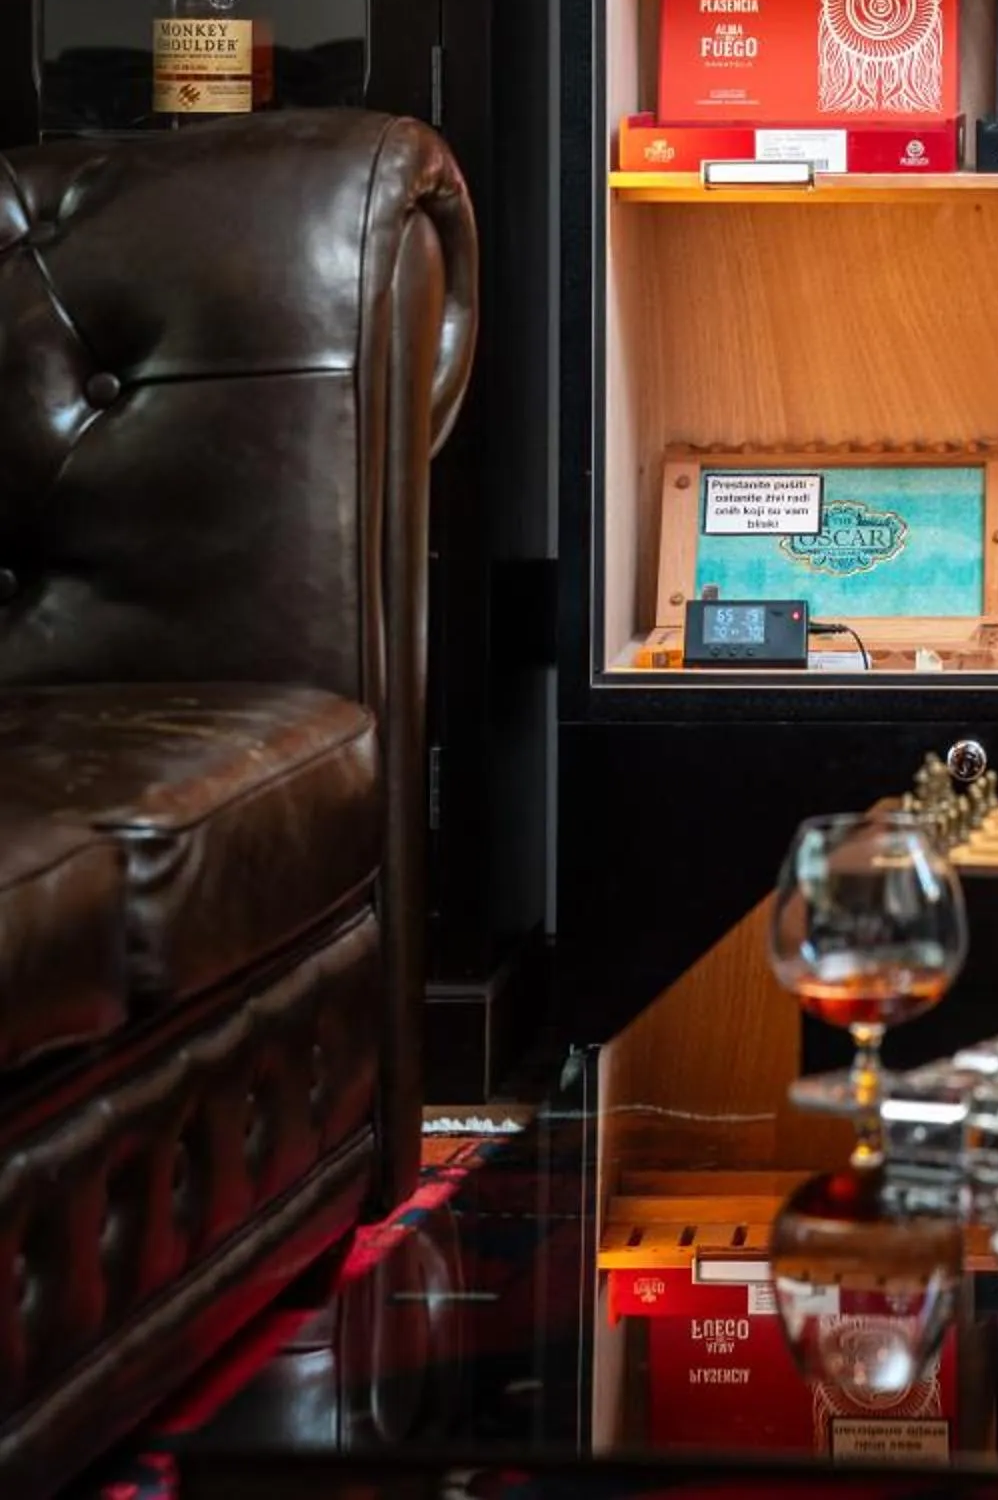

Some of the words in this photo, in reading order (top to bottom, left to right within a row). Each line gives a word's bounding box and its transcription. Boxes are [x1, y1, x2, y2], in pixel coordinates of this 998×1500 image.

[161, 22, 227, 37] MONKEY
[157, 38, 237, 51] OULDER
[701, 36, 758, 58] FUEGO
[711, 479, 771, 489] Prestanite
[773, 479, 807, 491] pušiti
[715, 493, 763, 503] ostanite
[743, 506, 765, 517] koji
[798, 529, 886, 548] OSCAR
